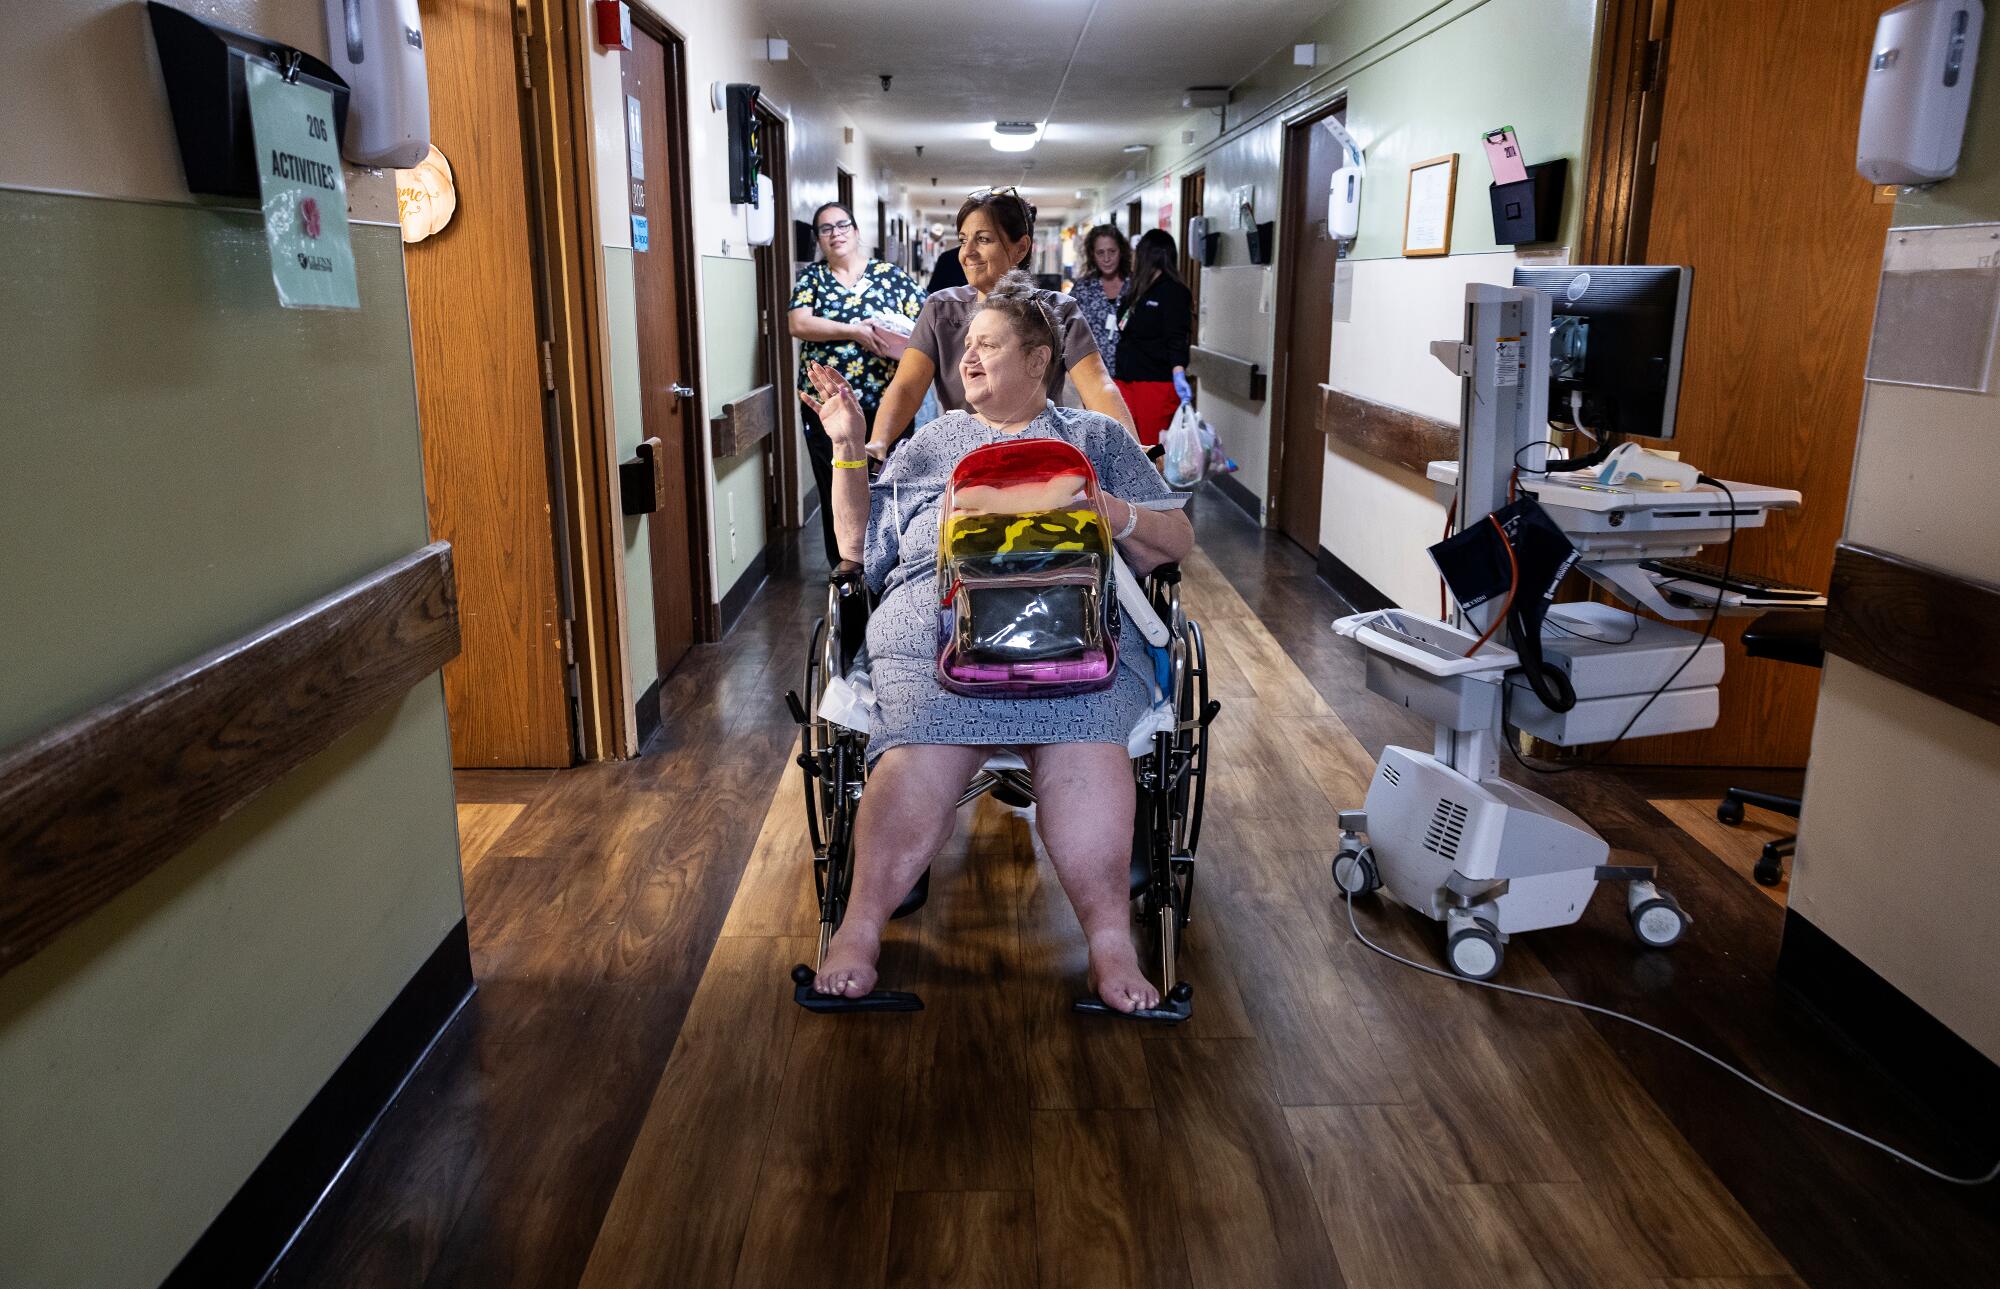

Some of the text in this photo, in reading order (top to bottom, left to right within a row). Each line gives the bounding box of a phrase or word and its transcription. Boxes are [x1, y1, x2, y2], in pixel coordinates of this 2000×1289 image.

[306, 113, 328, 142] 206
[271, 149, 336, 191] ACTIVITIES
[1472, 595, 1487, 605] INDEX
